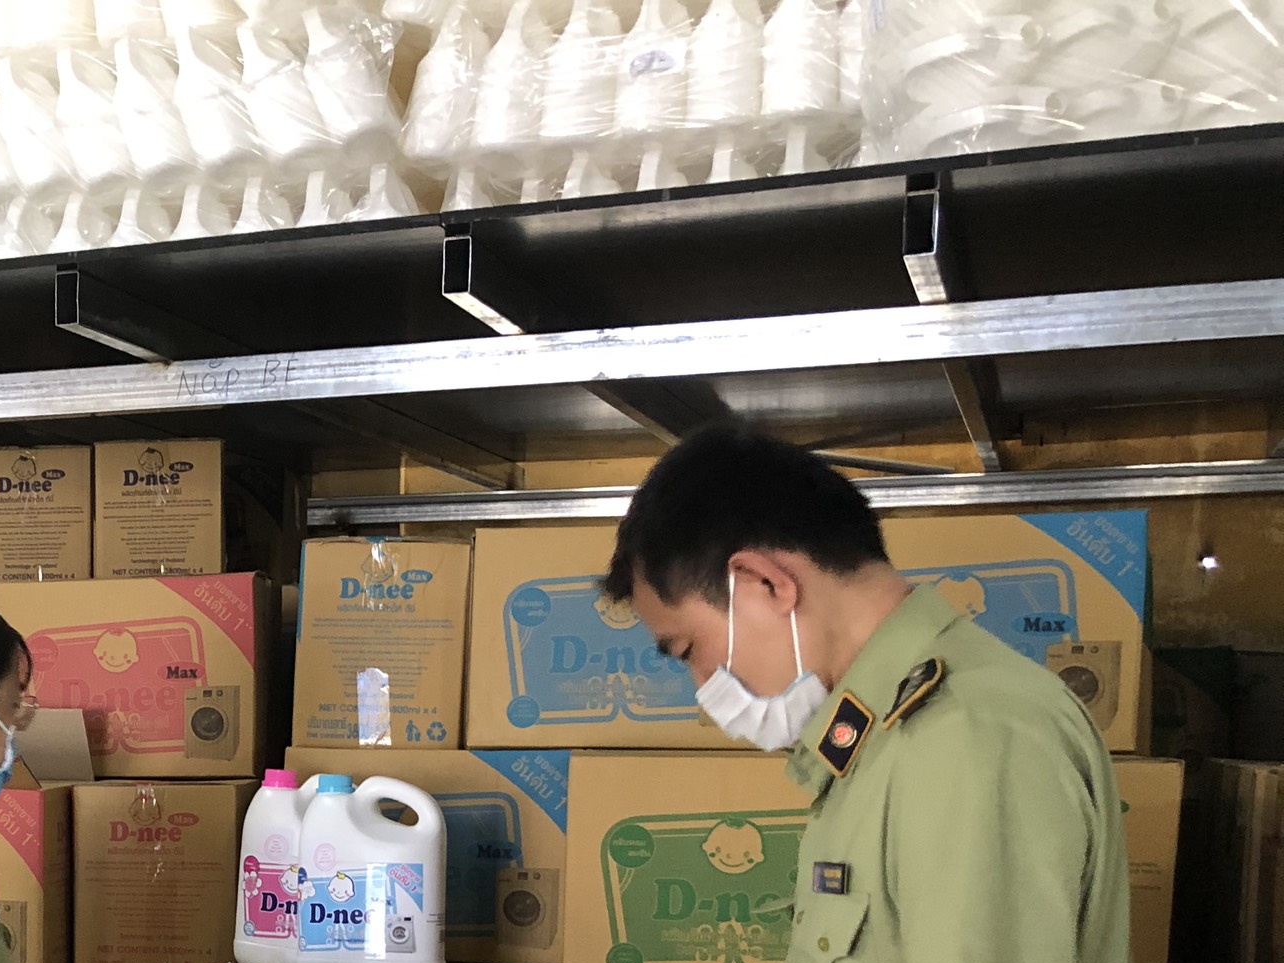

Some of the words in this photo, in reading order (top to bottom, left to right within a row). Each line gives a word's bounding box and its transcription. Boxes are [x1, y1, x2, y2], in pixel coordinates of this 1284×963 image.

[123, 469, 180, 486] D-nee
[340, 577, 414, 599] D-nee
[1022, 617, 1065, 633] Max
[166, 666, 198, 679] Max
[319, 704, 336, 712] NET
[432, 706, 438, 714] 4
[109, 821, 182, 842] D-nee
[477, 844, 513, 859] Max
[261, 892, 298, 915] D-n
[653, 877, 785, 924] D-ne
